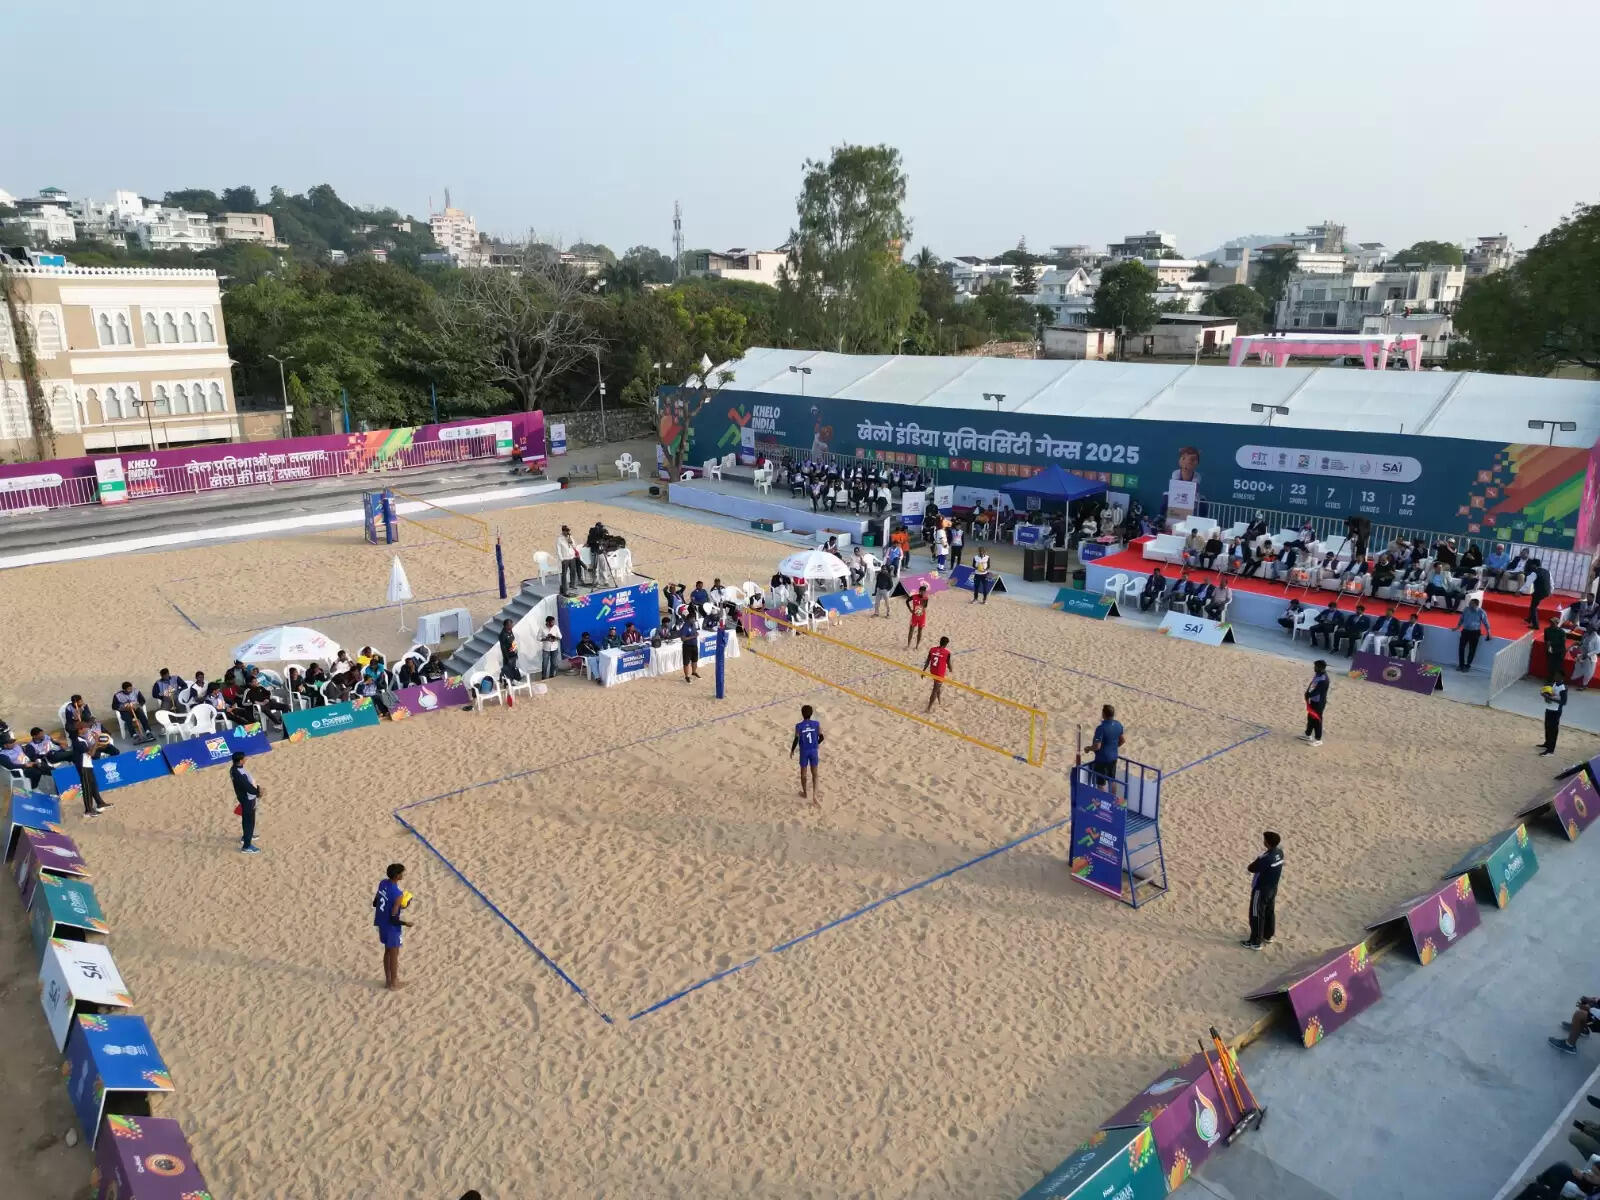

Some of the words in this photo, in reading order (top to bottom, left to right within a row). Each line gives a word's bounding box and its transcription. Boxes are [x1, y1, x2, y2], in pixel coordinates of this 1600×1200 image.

[753, 405, 781, 419] KHELO
[752, 417, 776, 430] INDIA
[856, 419, 893, 442] खेलो
[895, 422, 940, 446] इंडिया
[943, 426, 1033, 456] यूनिवर्सिटी
[1035, 433, 1083, 460] गेम्स
[1085, 442, 1140, 464] 2025
[1251, 452, 1268, 461] FIT
[127, 458, 157, 470] KHELO
[1232, 479, 1275, 492] 5000+
[1290, 484, 1307, 495] 23
[1327, 488, 1336, 499] 7
[1361, 491, 1376, 503] 13
[1401, 494, 1417, 506] 12
[1183, 622, 1203, 634] SAI
[806, 732, 813, 744] 1
[379, 896, 386, 912] 2
[73, 960, 103, 980] SAI
